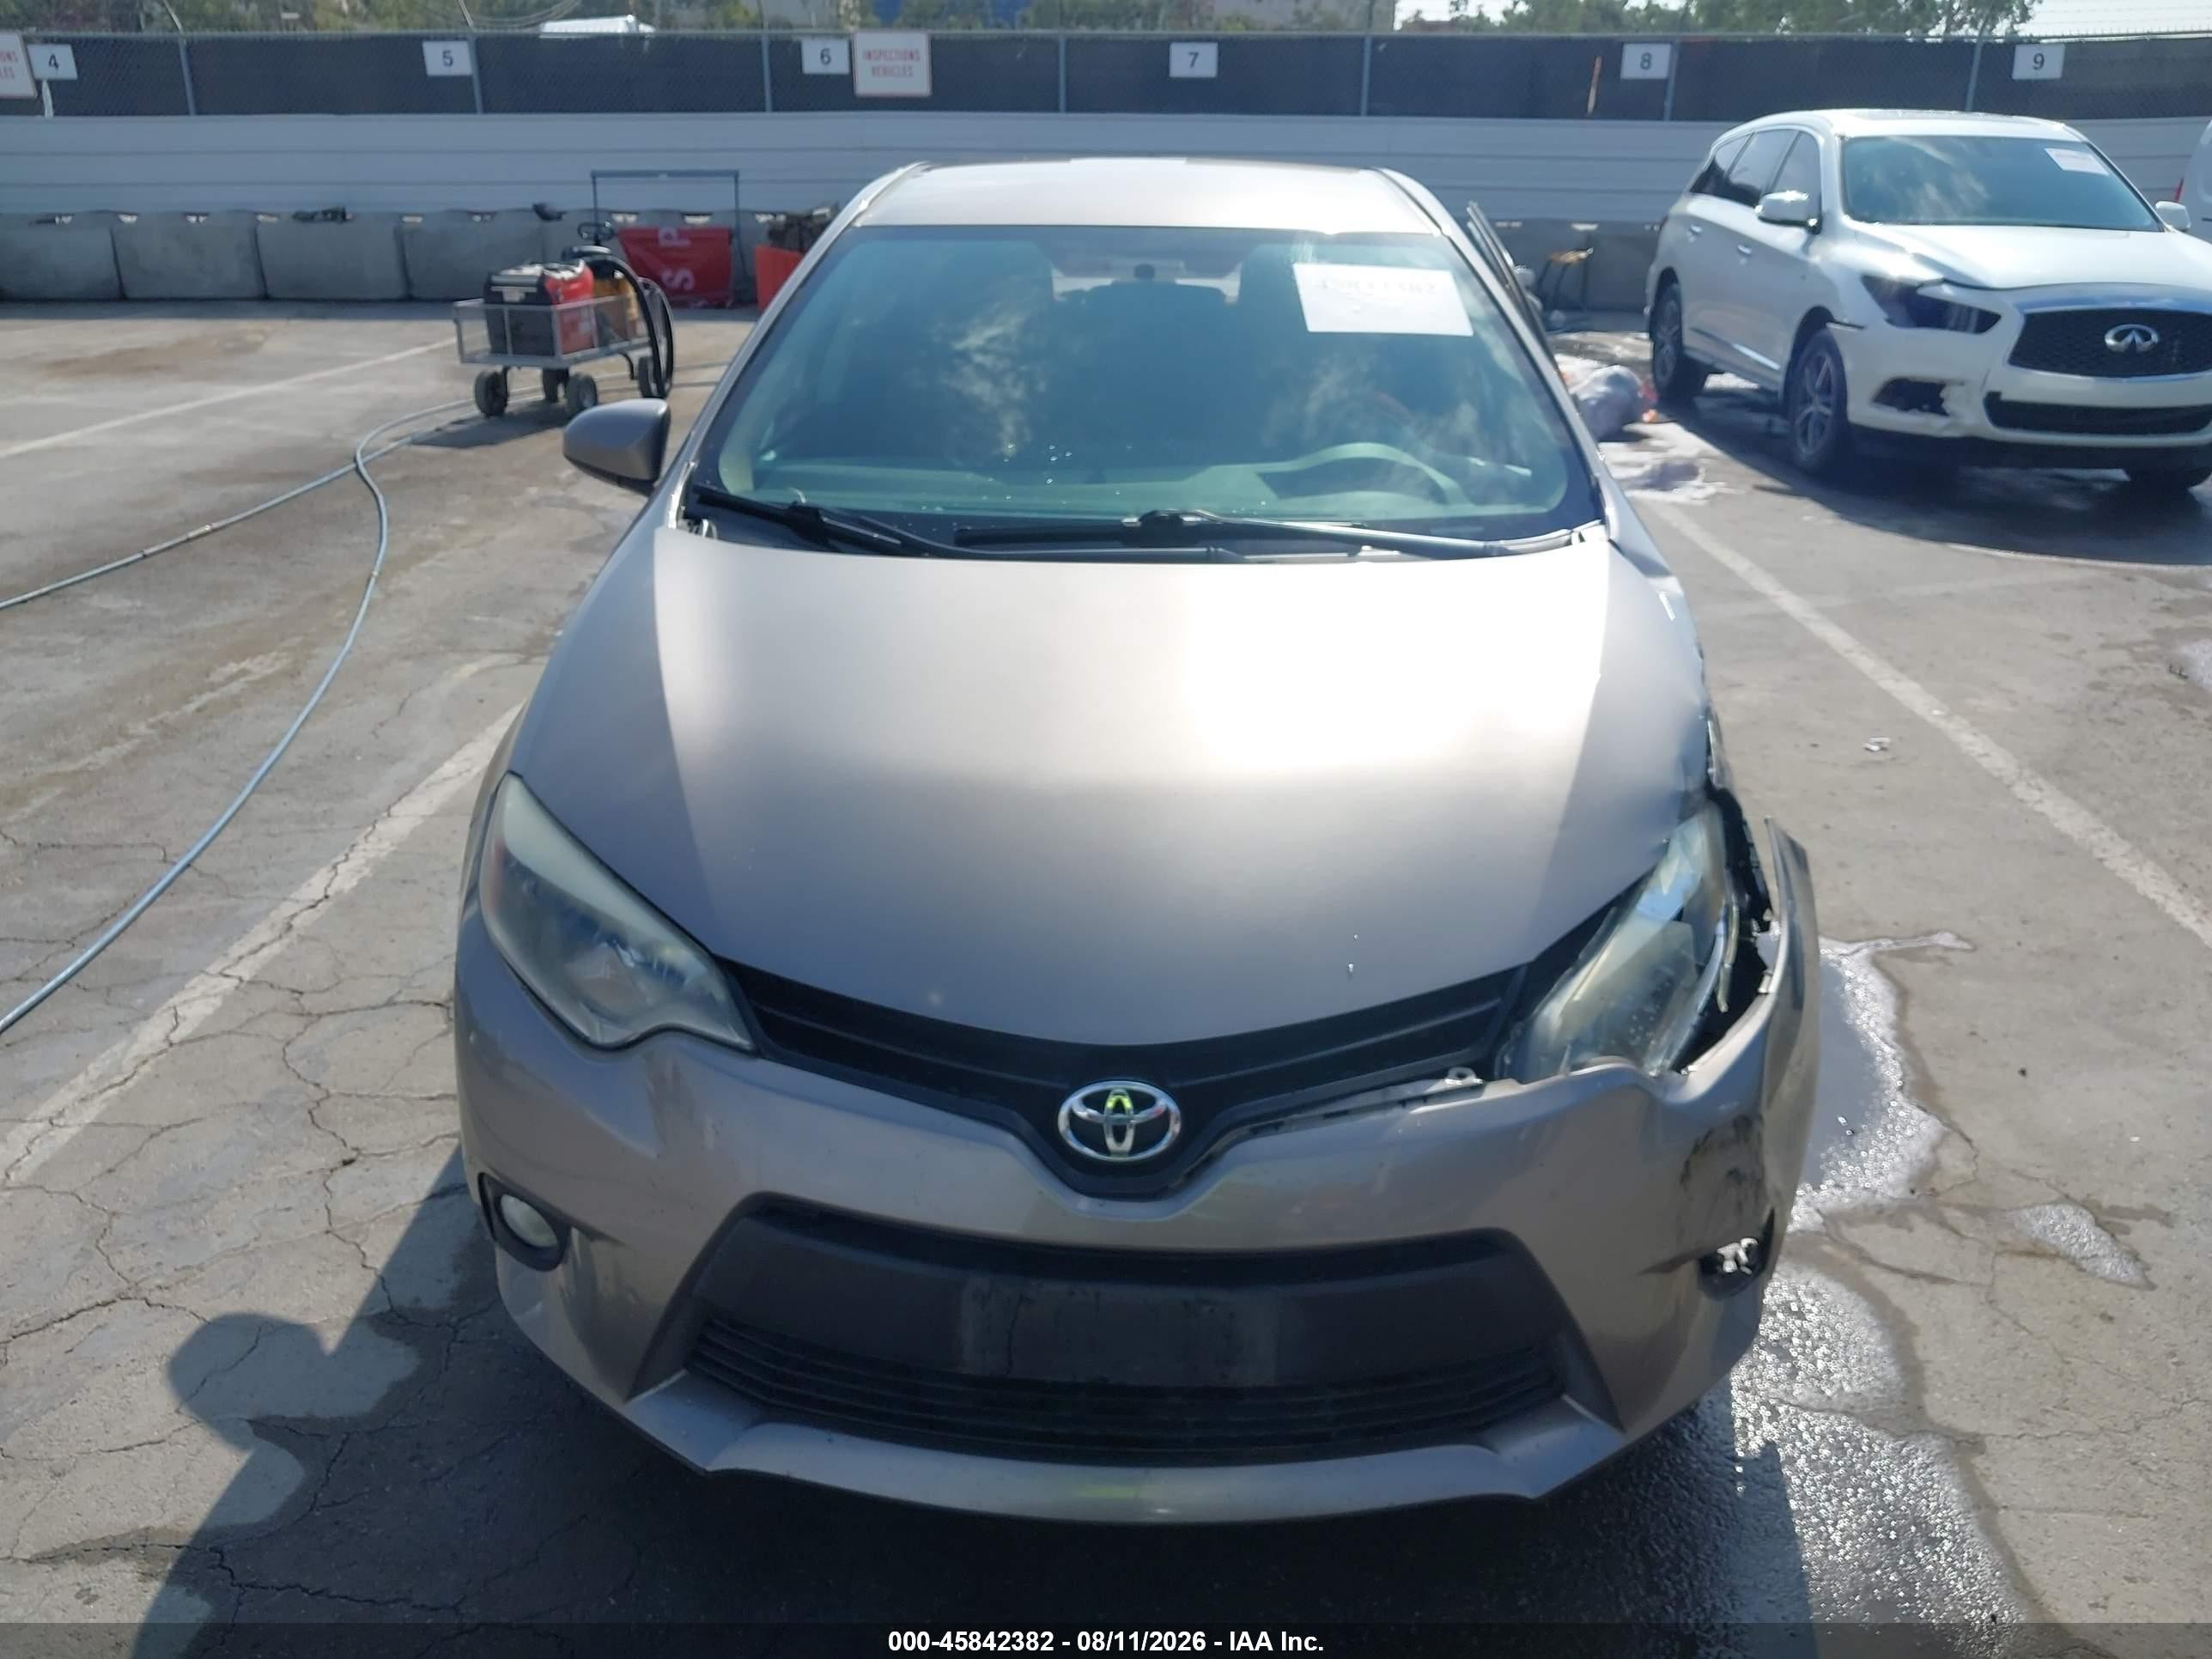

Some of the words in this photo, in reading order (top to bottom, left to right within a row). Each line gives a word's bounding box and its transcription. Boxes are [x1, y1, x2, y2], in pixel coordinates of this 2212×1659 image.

[48, 53, 59, 69] 4
[442, 50, 453, 66] 5
[820, 47, 831, 65] 6
[1188, 52, 1199, 68] 7
[1640, 52, 1652, 70] 8
[2033, 52, 2045, 70] 9
